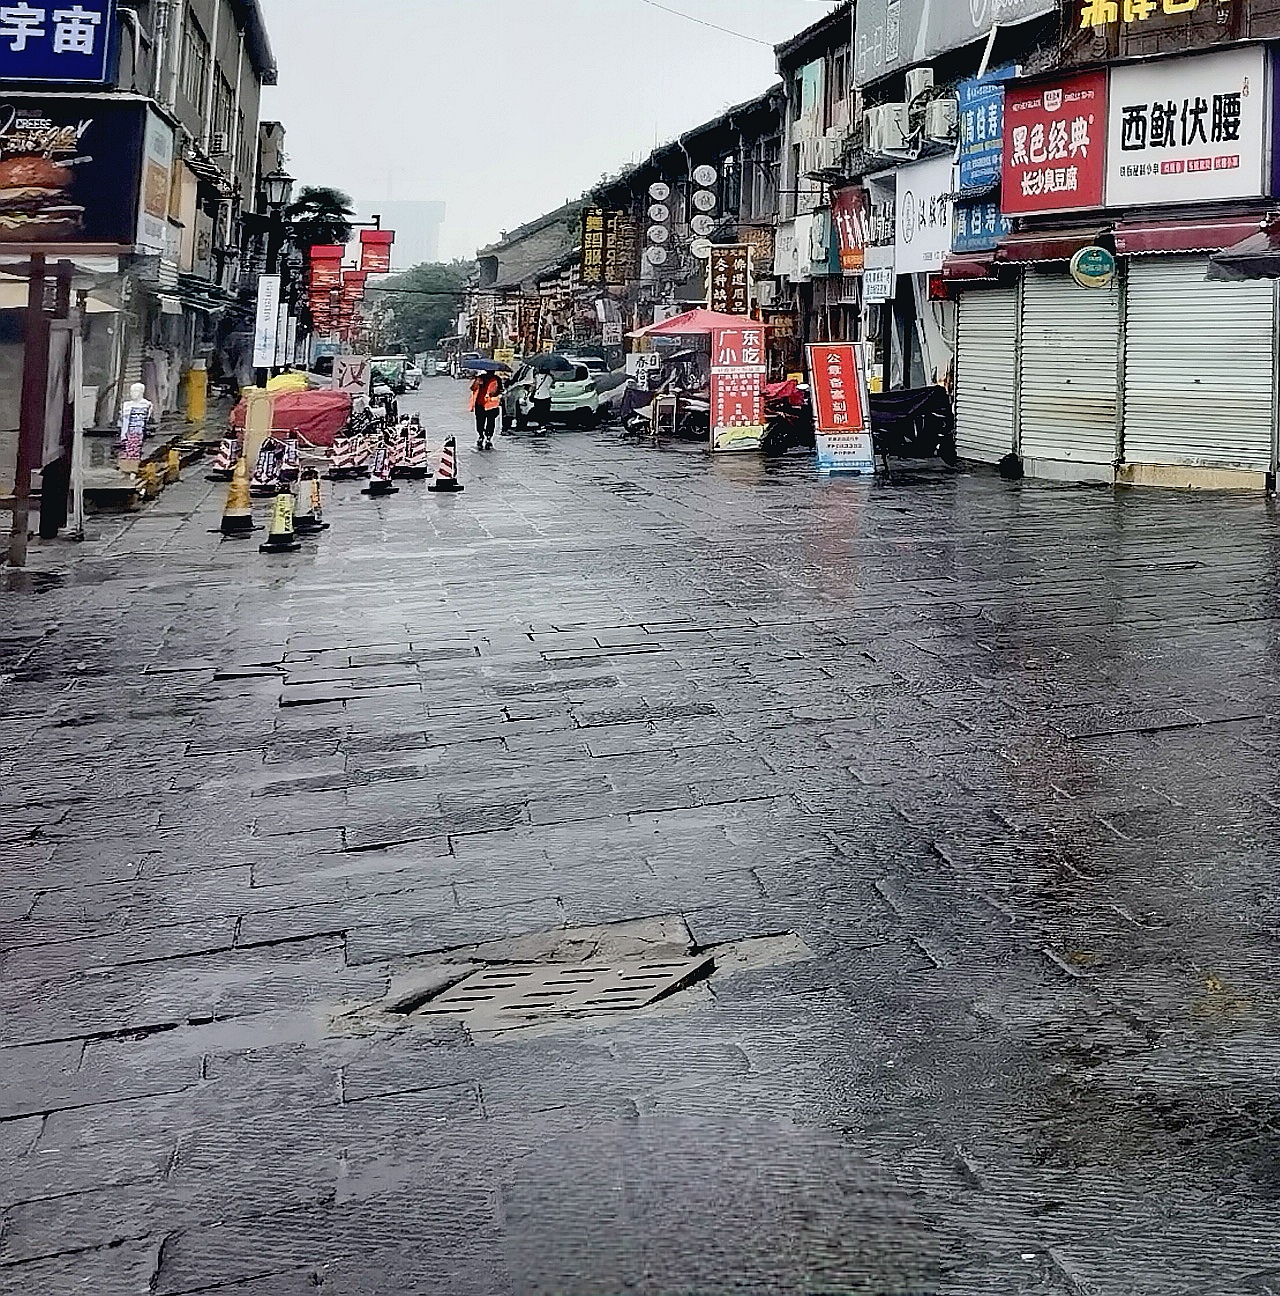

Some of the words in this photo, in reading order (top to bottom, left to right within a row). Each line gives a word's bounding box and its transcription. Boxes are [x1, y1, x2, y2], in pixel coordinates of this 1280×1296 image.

[0, 2, 101, 55] 宇宙
[1011, 115, 1090, 167] 黑色经典
[1121, 92, 1241, 151] 西鱿伏腰
[1021, 165, 1079, 197] 长沙臭豆腐
[718, 329, 760, 347] 广东
[718, 347, 760, 366] 小吃
